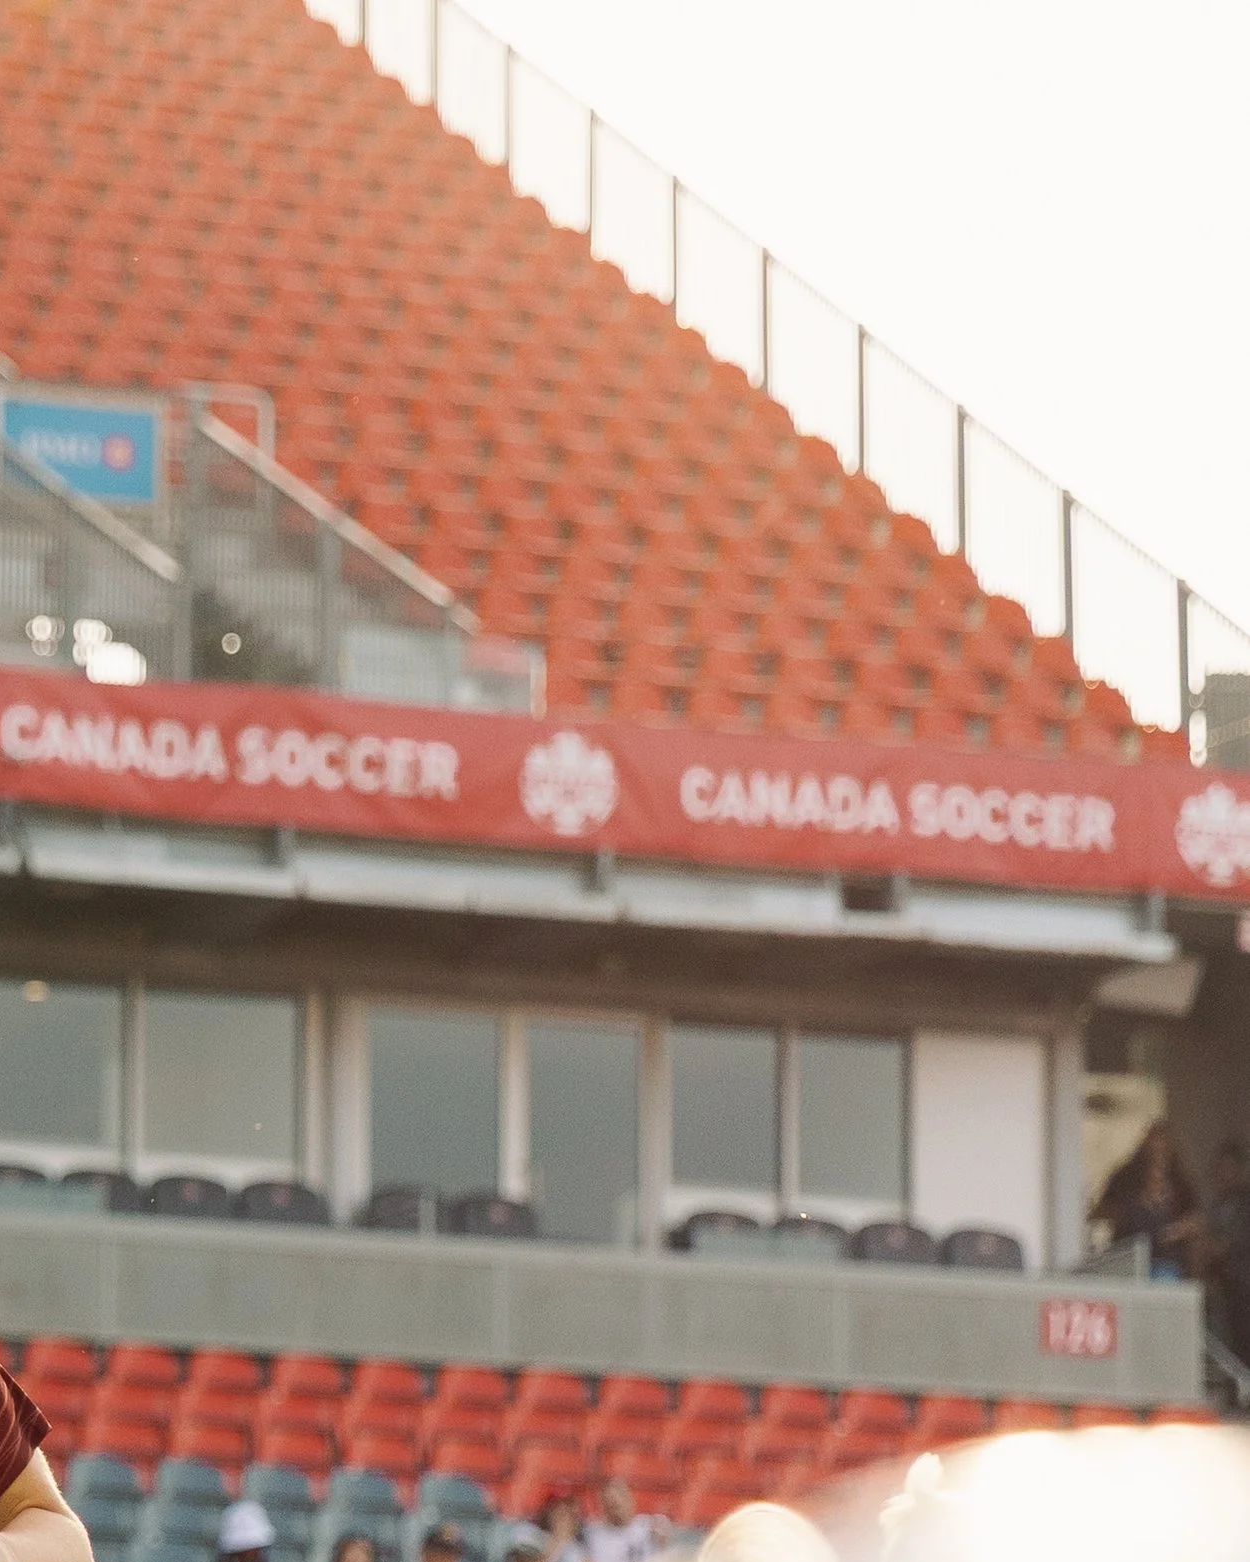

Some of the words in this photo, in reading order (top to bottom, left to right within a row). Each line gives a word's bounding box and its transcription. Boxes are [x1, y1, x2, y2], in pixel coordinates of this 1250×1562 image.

[235, 724, 460, 800] SOCCER
[679, 765, 900, 836] CANADA
[907, 780, 1117, 853] SOCCER
